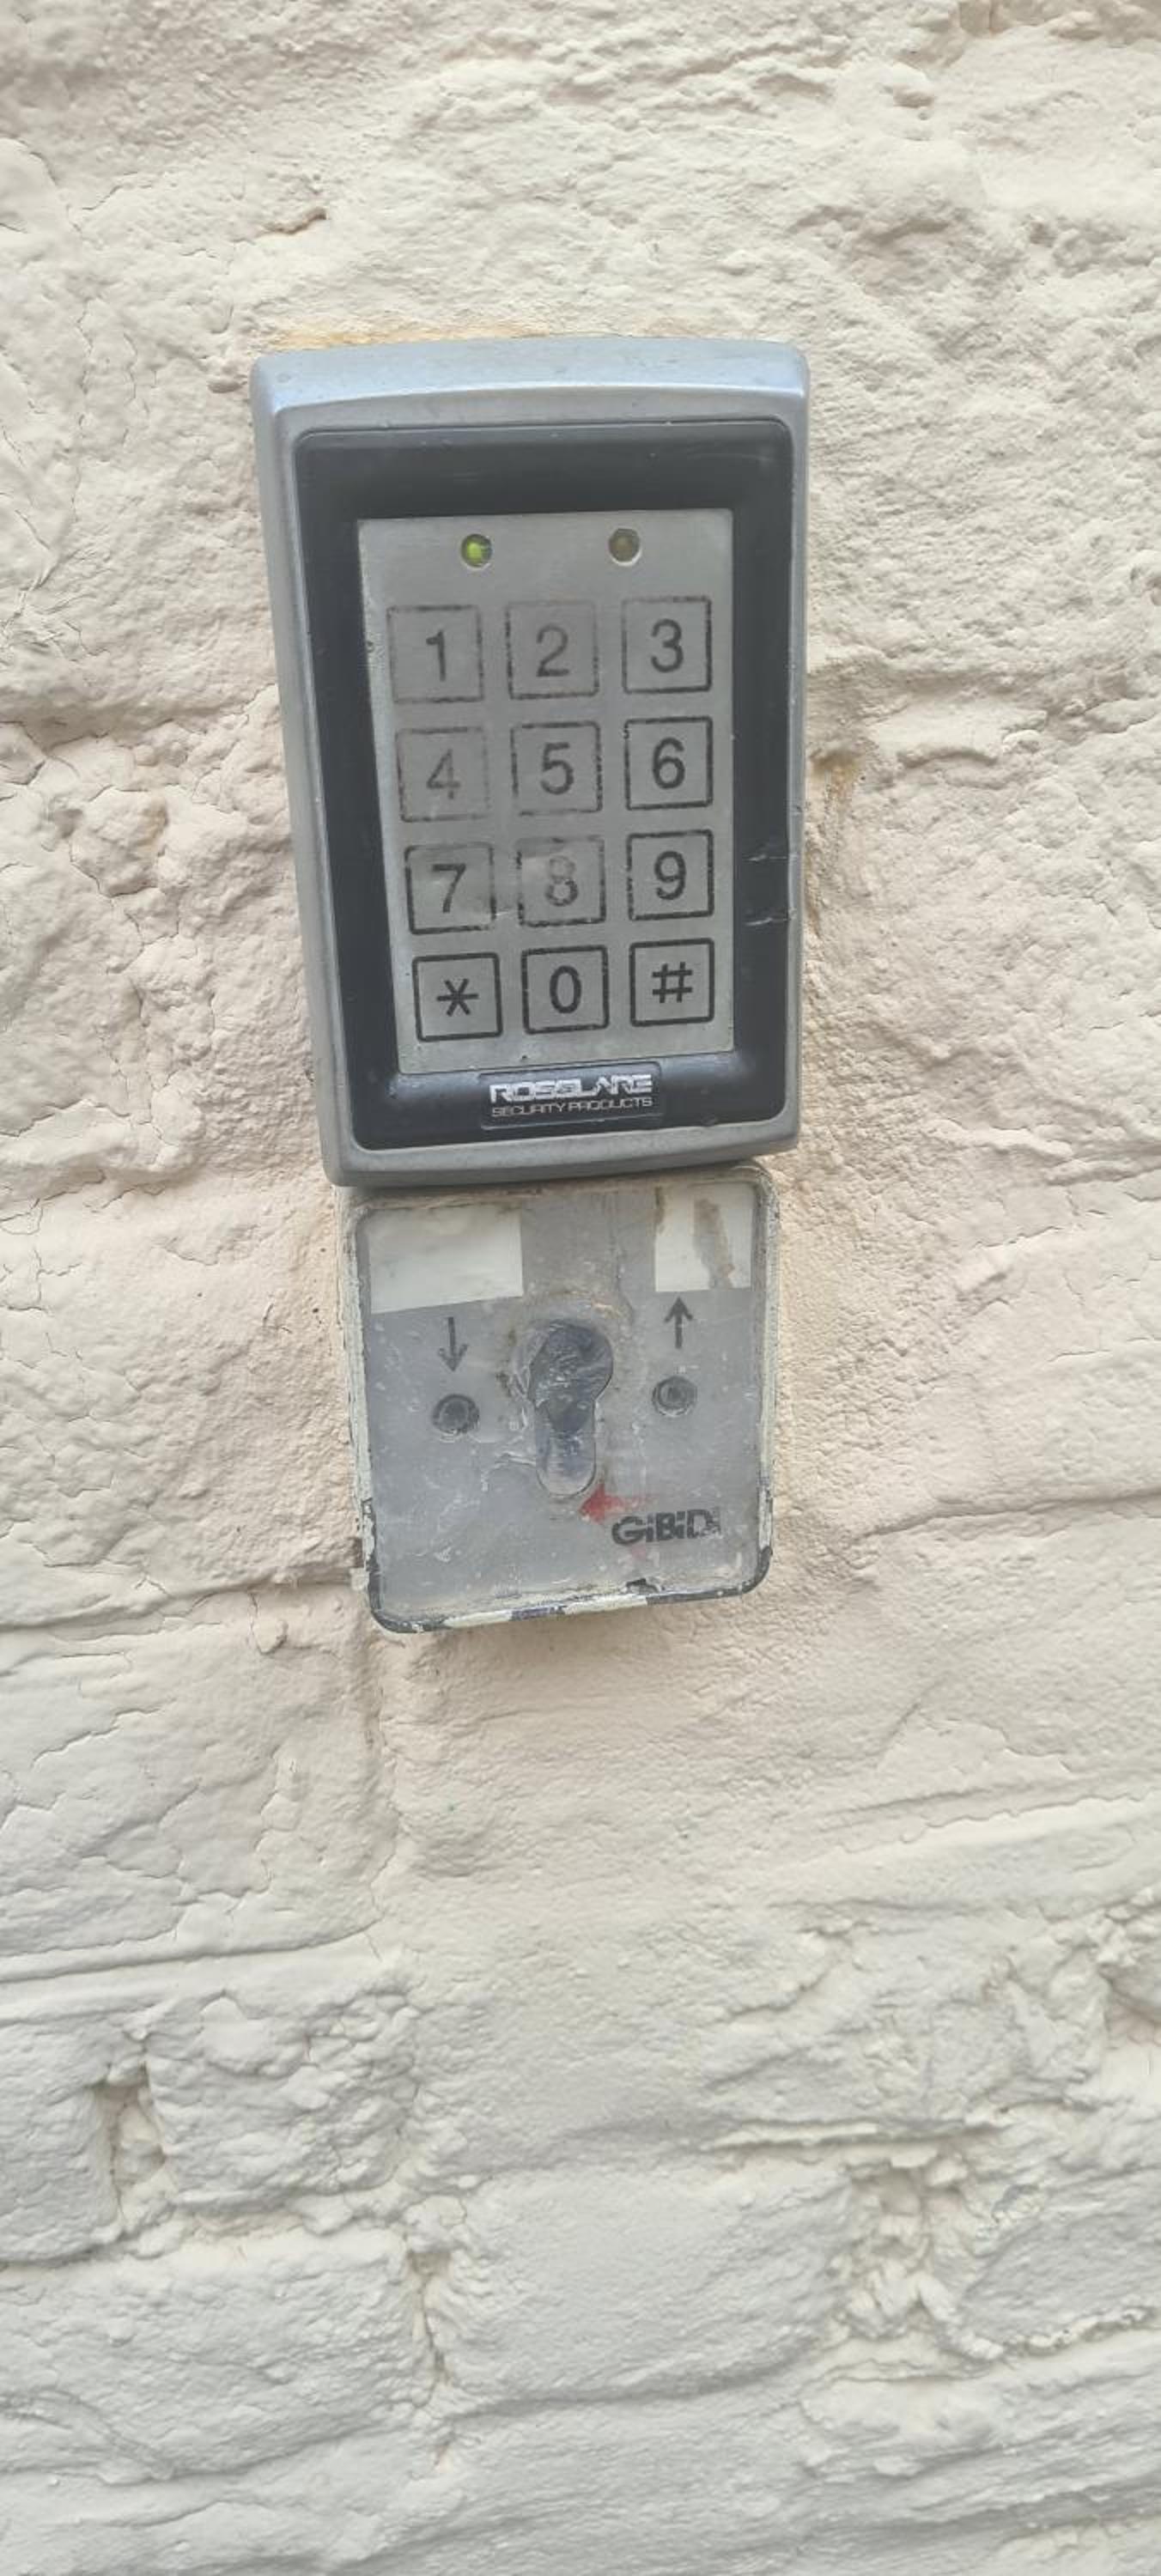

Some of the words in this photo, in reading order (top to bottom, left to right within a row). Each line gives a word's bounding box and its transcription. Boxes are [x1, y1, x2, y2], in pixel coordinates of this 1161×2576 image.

[426, 629, 447, 682] 1
[536, 624, 570, 678] 2
[650, 618, 684, 673] 3
[426, 748, 461, 799] 4
[540, 742, 574, 795] 5
[652, 737, 686, 790] 6
[431, 863, 466, 914] 7
[544, 856, 579, 907] 8
[653, 850, 686, 901] 9
[549, 964, 582, 1014] 0
[491, 1103, 566, 1118] SECURITY
[568, 1096, 653, 1112] PRODUCTS
